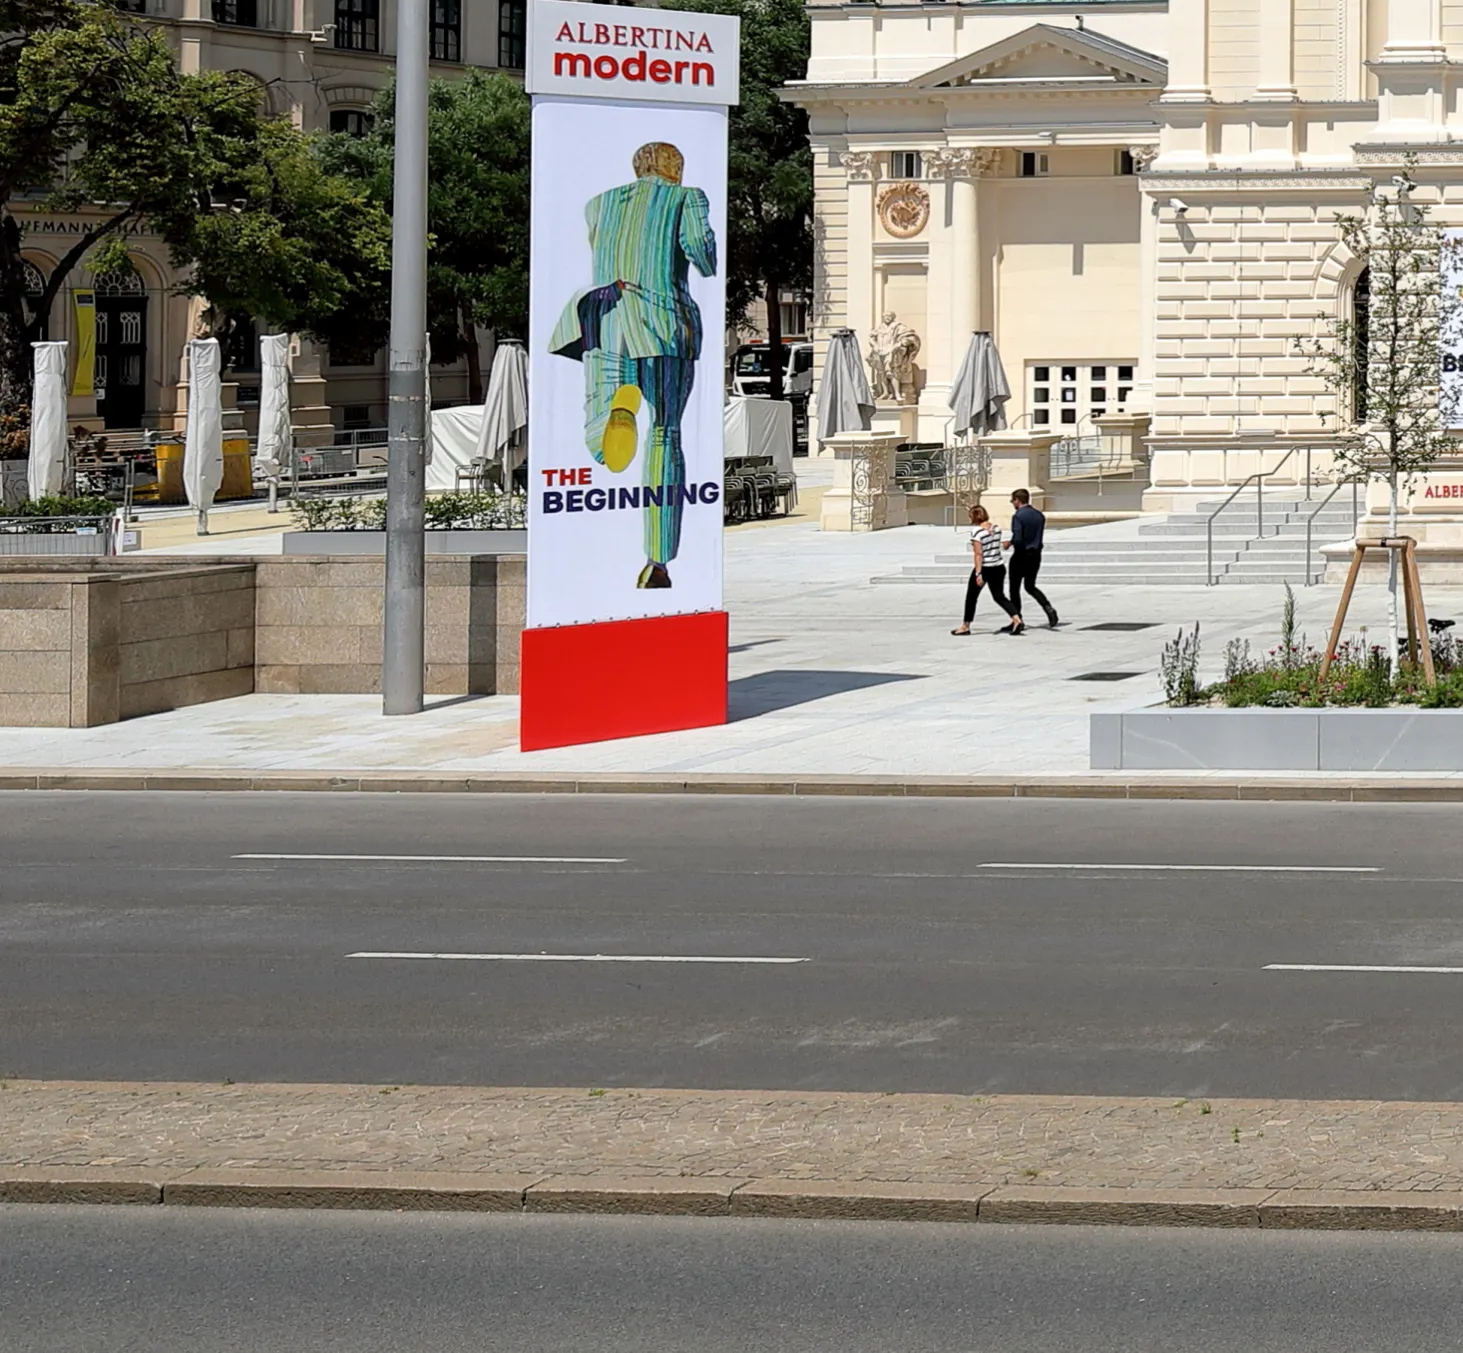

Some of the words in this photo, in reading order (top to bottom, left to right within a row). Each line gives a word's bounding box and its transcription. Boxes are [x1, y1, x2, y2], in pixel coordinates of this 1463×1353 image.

[555, 21, 714, 53] ALBERTINA
[554, 51, 715, 86] modern
[542, 467, 592, 486] THE
[543, 482, 720, 514] BEGINNING
